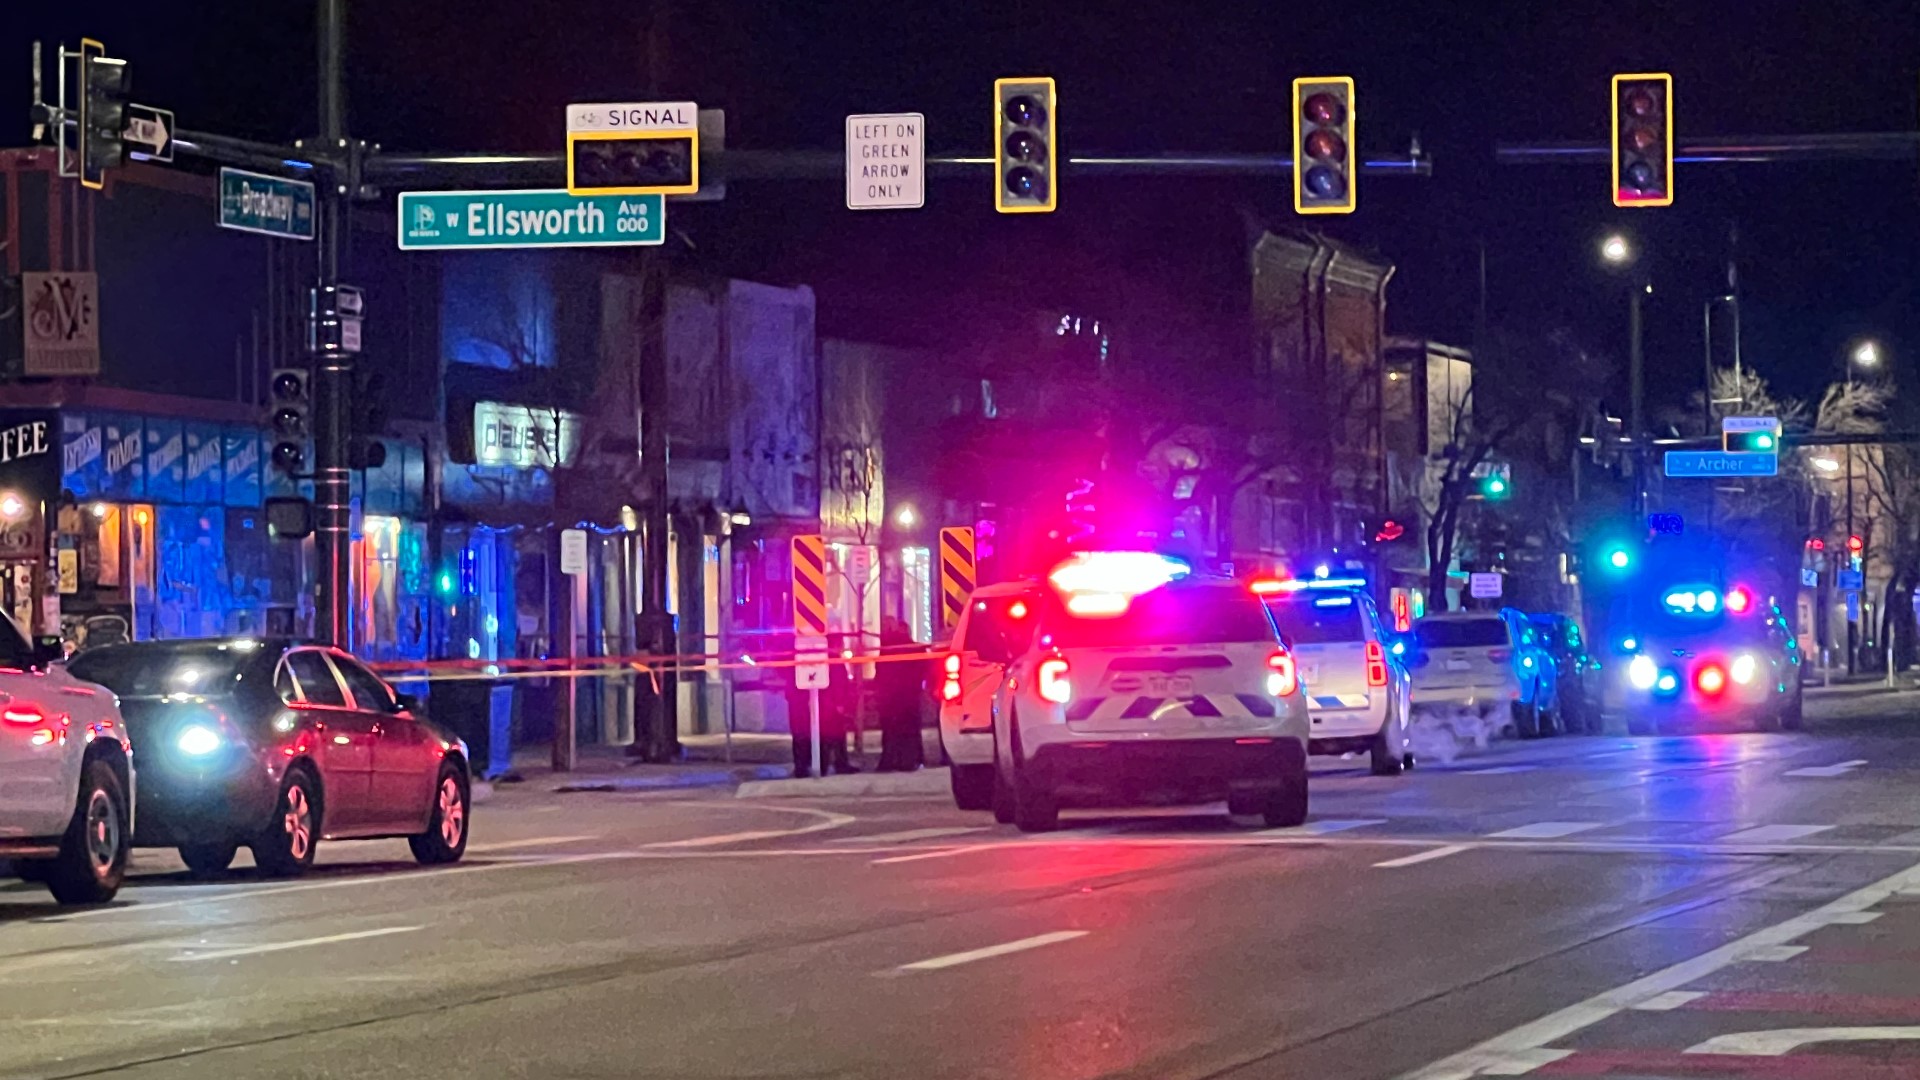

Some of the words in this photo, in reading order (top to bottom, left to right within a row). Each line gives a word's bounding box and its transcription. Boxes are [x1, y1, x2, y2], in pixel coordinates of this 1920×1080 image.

[609, 109, 688, 126] SIGNAL
[856, 125, 888, 139] LEFT
[897, 124, 914, 137] ON
[862, 144, 909, 158] GREEN
[862, 164, 909, 178] ARROW
[868, 184, 902, 198] ONLY
[242, 181, 294, 232] Broadway
[446, 213, 459, 228] W
[468, 201, 605, 237] Ellsworth
[618, 200, 648, 216] Ave
[616, 217, 649, 233] 000
[1698, 457, 1743, 471] Archer
